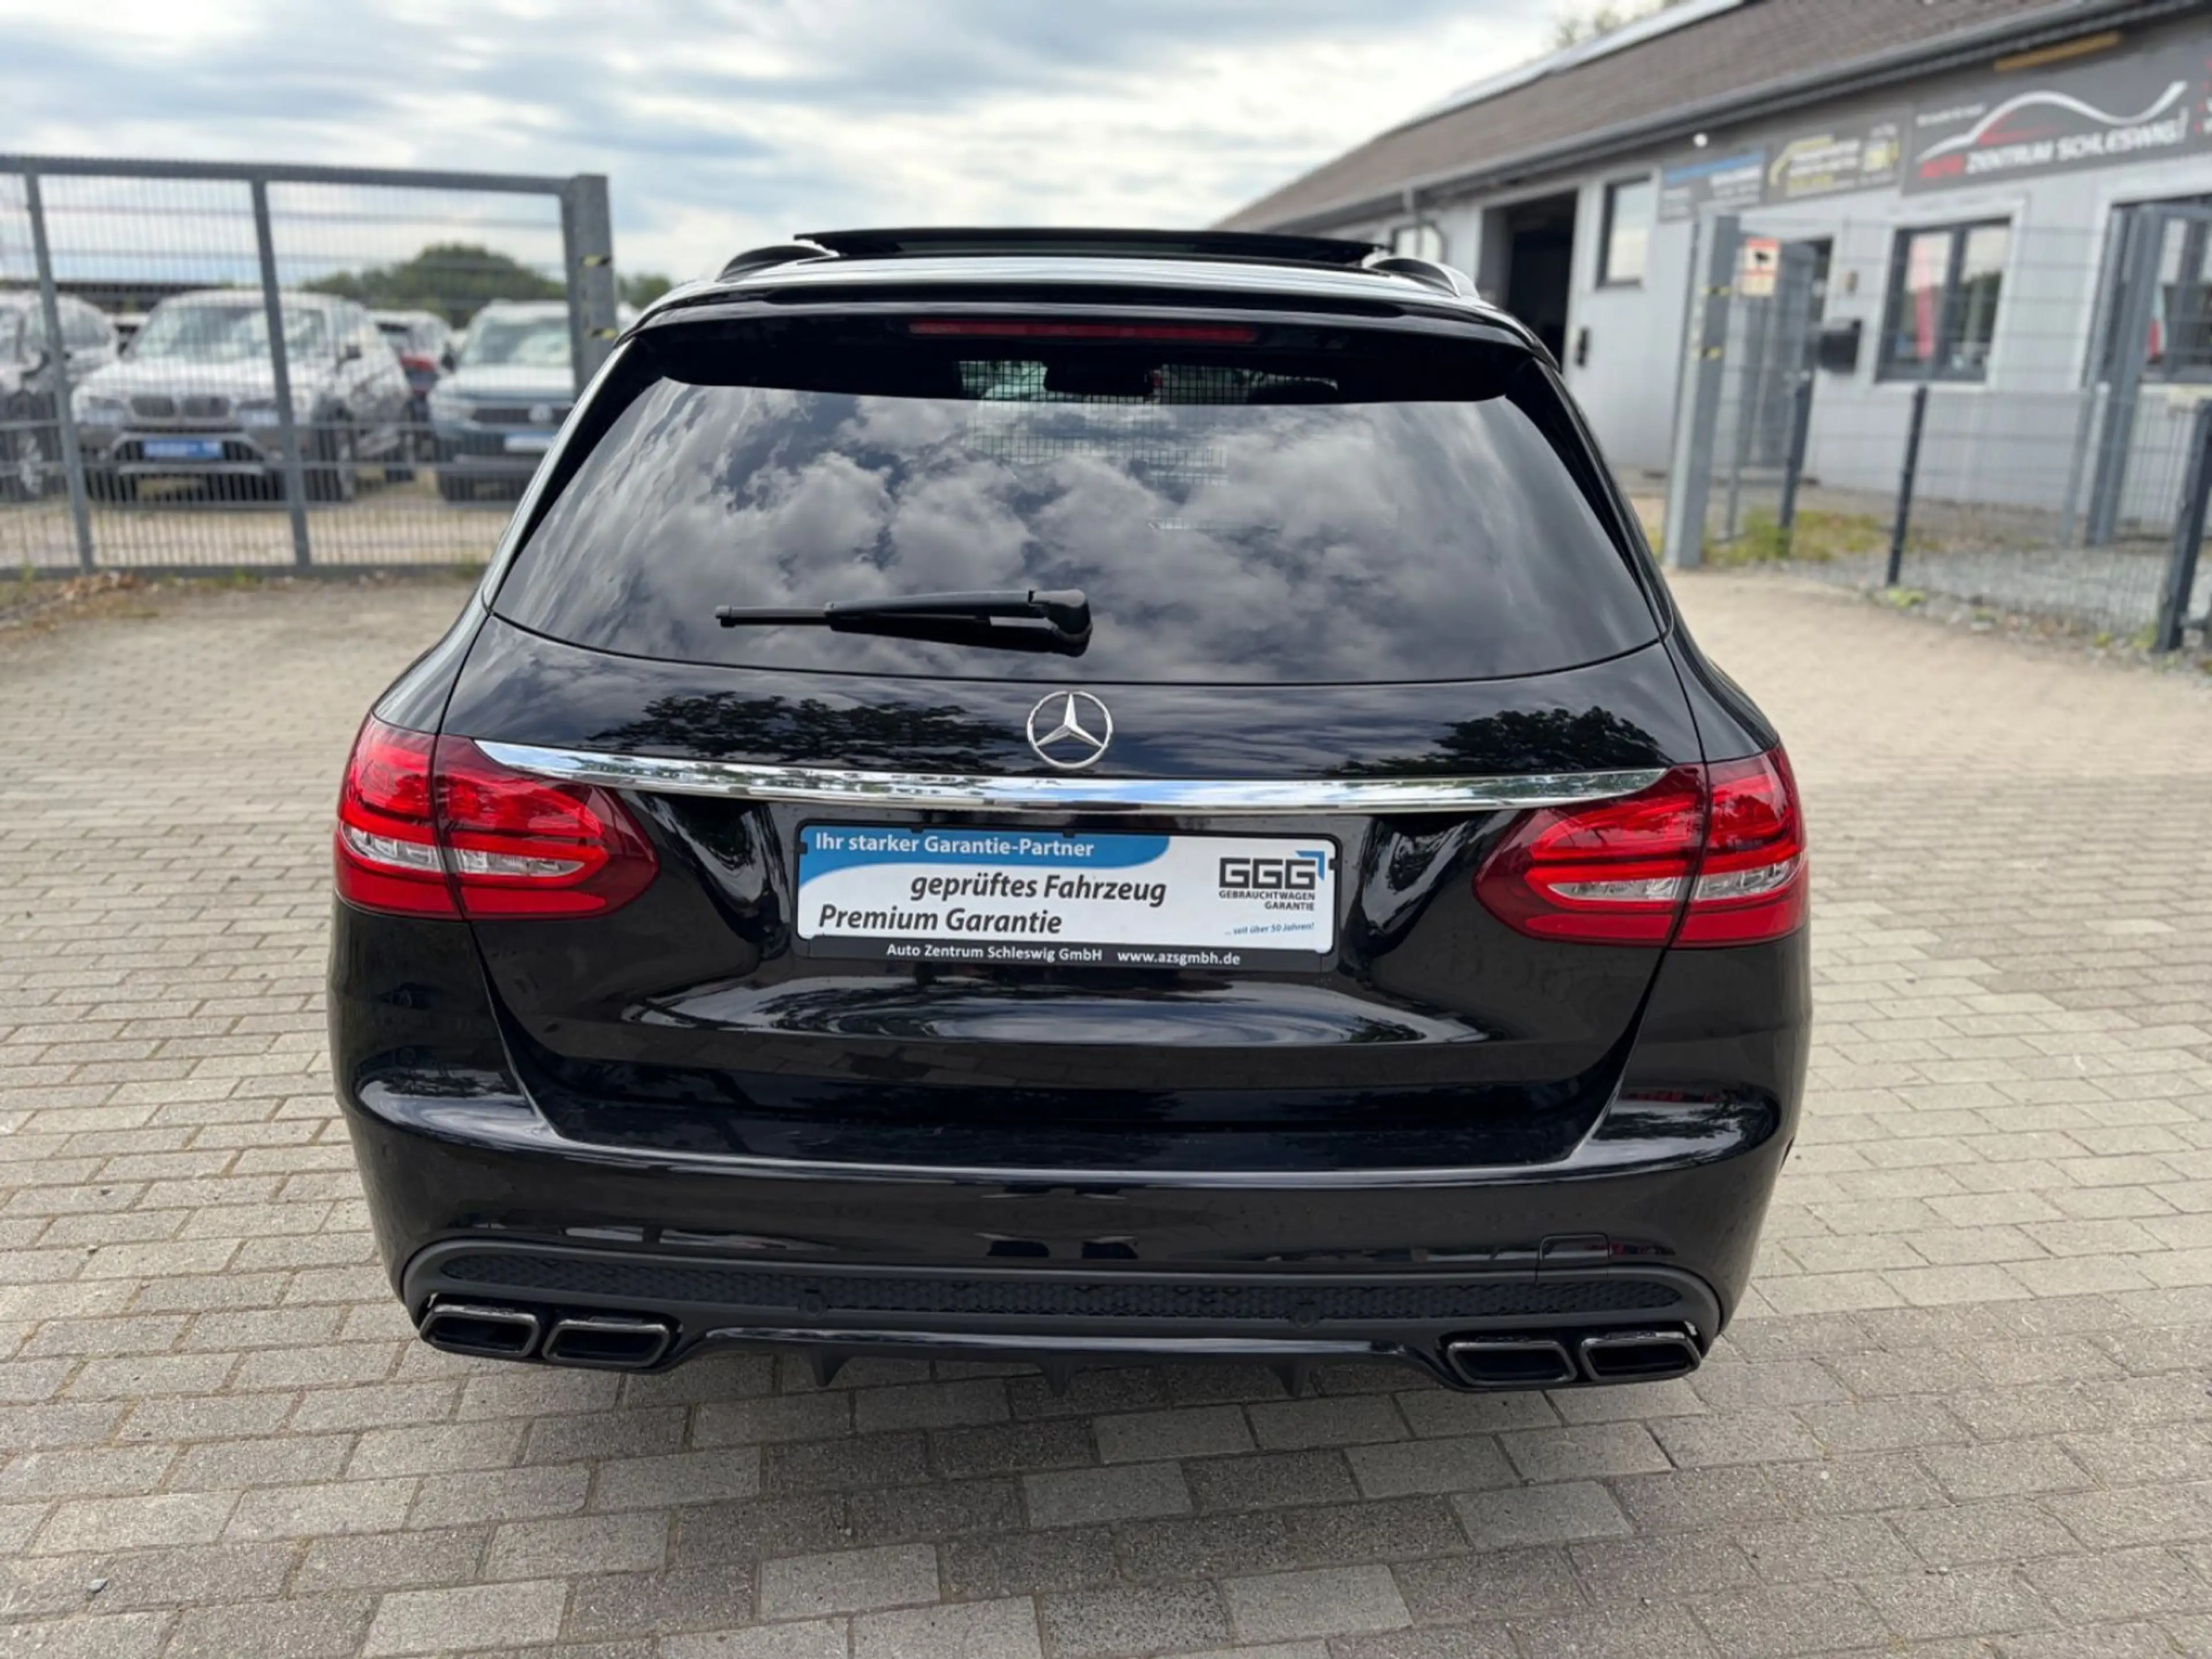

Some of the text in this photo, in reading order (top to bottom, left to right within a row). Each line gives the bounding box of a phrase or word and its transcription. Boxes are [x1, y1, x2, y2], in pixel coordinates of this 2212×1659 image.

[816, 832, 1094, 857] Ihr starker Garantie-Partner
[1219, 858, 1316, 890] GGG
[910, 872, 1167, 908] geprüftes Fahrzeug
[1219, 891, 1315, 900] GEBRAUCHTWAGEN
[1264, 902, 1315, 911] GARANTIE
[819, 904, 1062, 934] Premium Garantie
[1234, 926, 1248, 935] seit
[1249, 926, 1268, 934] über
[1270, 924, 1282, 932] 50
[887, 944, 1241, 966] Auto Zentrum Schleswig GmbH www.azsgmbh.de
